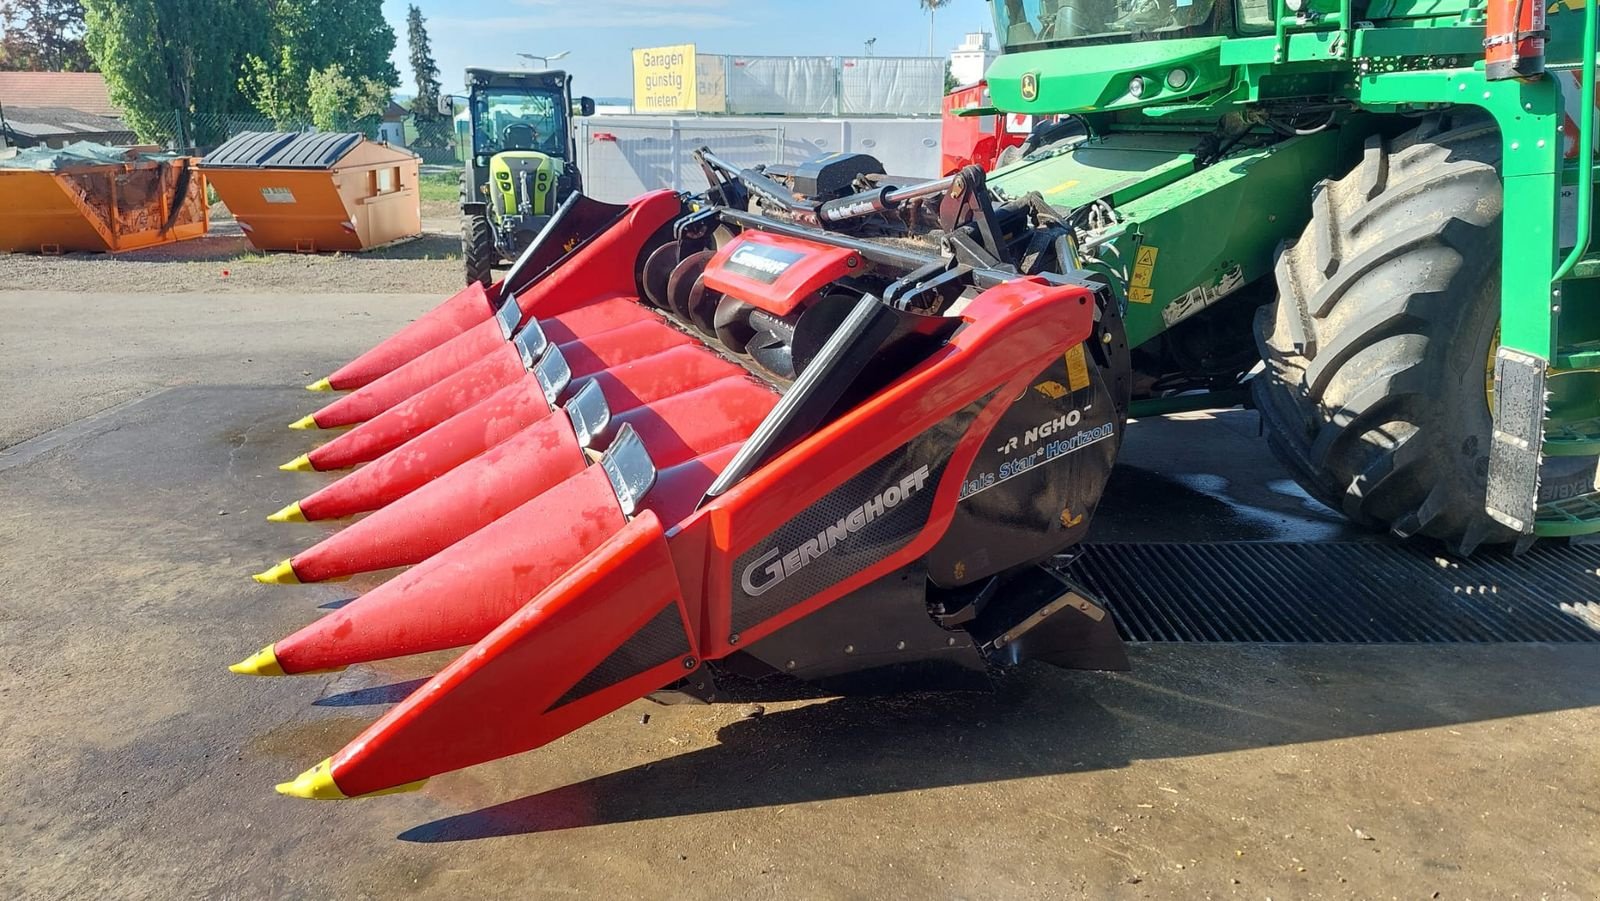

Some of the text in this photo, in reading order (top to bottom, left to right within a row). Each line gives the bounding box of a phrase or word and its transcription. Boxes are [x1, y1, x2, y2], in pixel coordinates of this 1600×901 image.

[643, 52, 683, 69] Garagen
[645, 72, 682, 91] günstig
[645, 93, 678, 107] mieten
[1046, 422, 1113, 460] Horizon
[741, 464, 930, 597] GERINGHOFF
